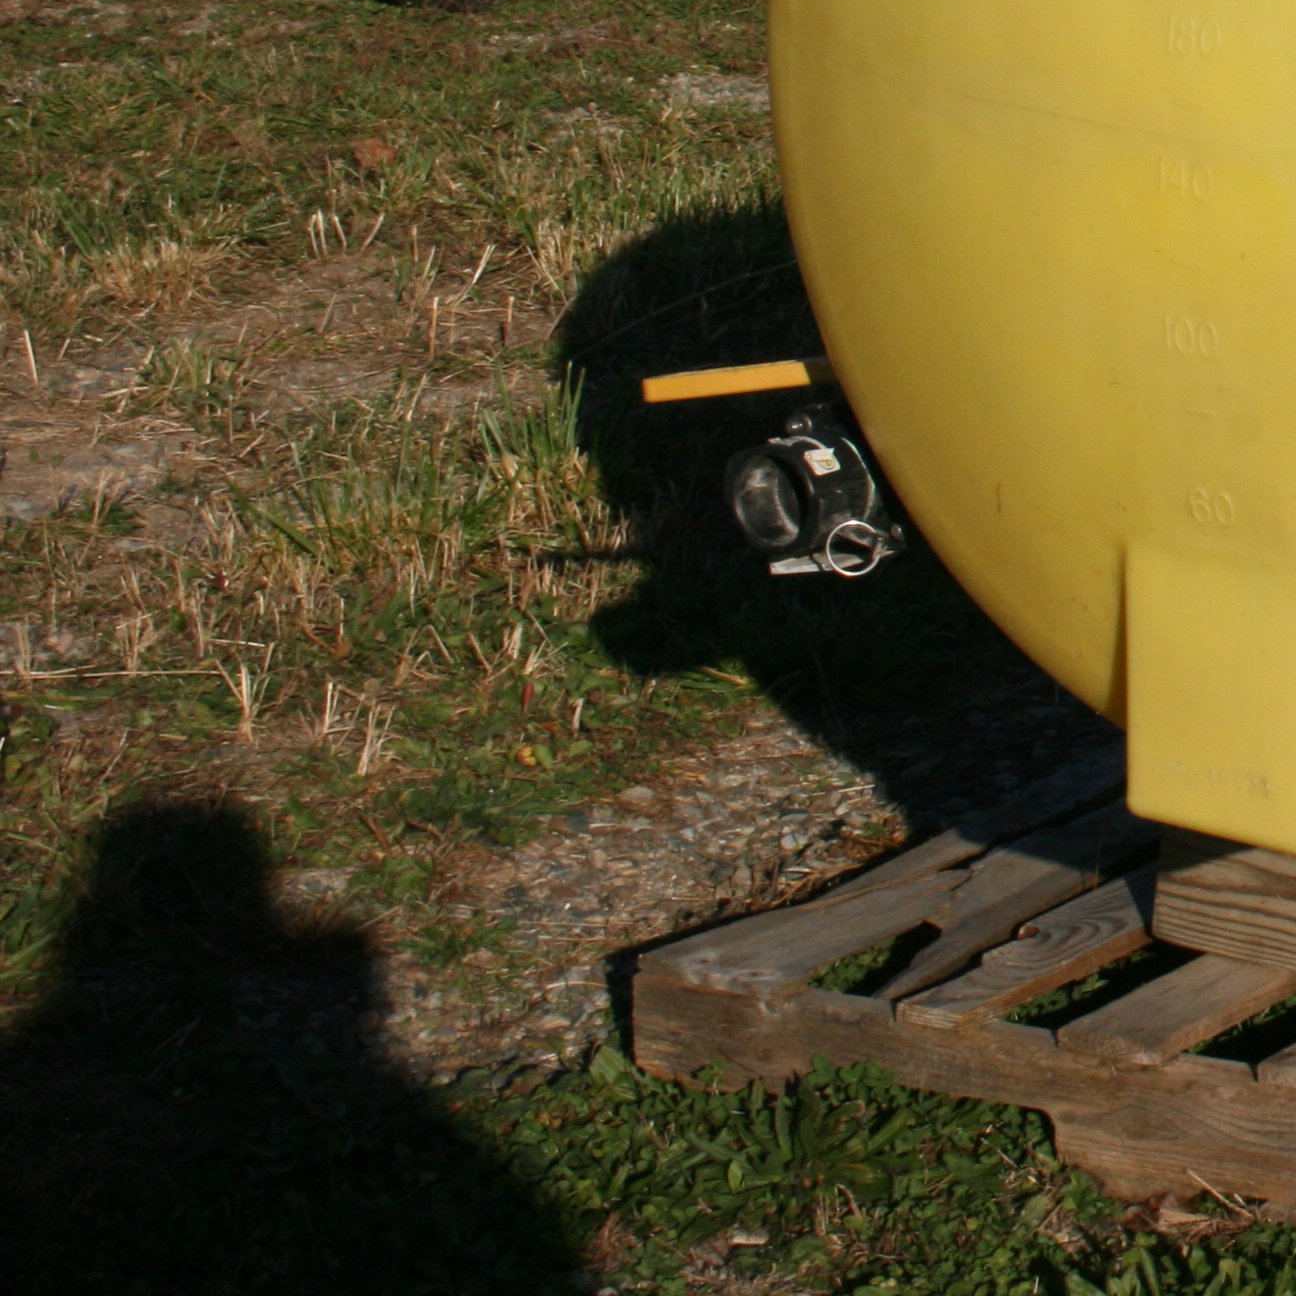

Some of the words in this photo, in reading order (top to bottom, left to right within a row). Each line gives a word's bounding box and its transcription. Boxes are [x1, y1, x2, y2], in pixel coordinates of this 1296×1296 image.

[1158, 156, 1212, 202] 140
[1165, 315, 1219, 357] 100
[1189, 486, 1235, 527] 60
